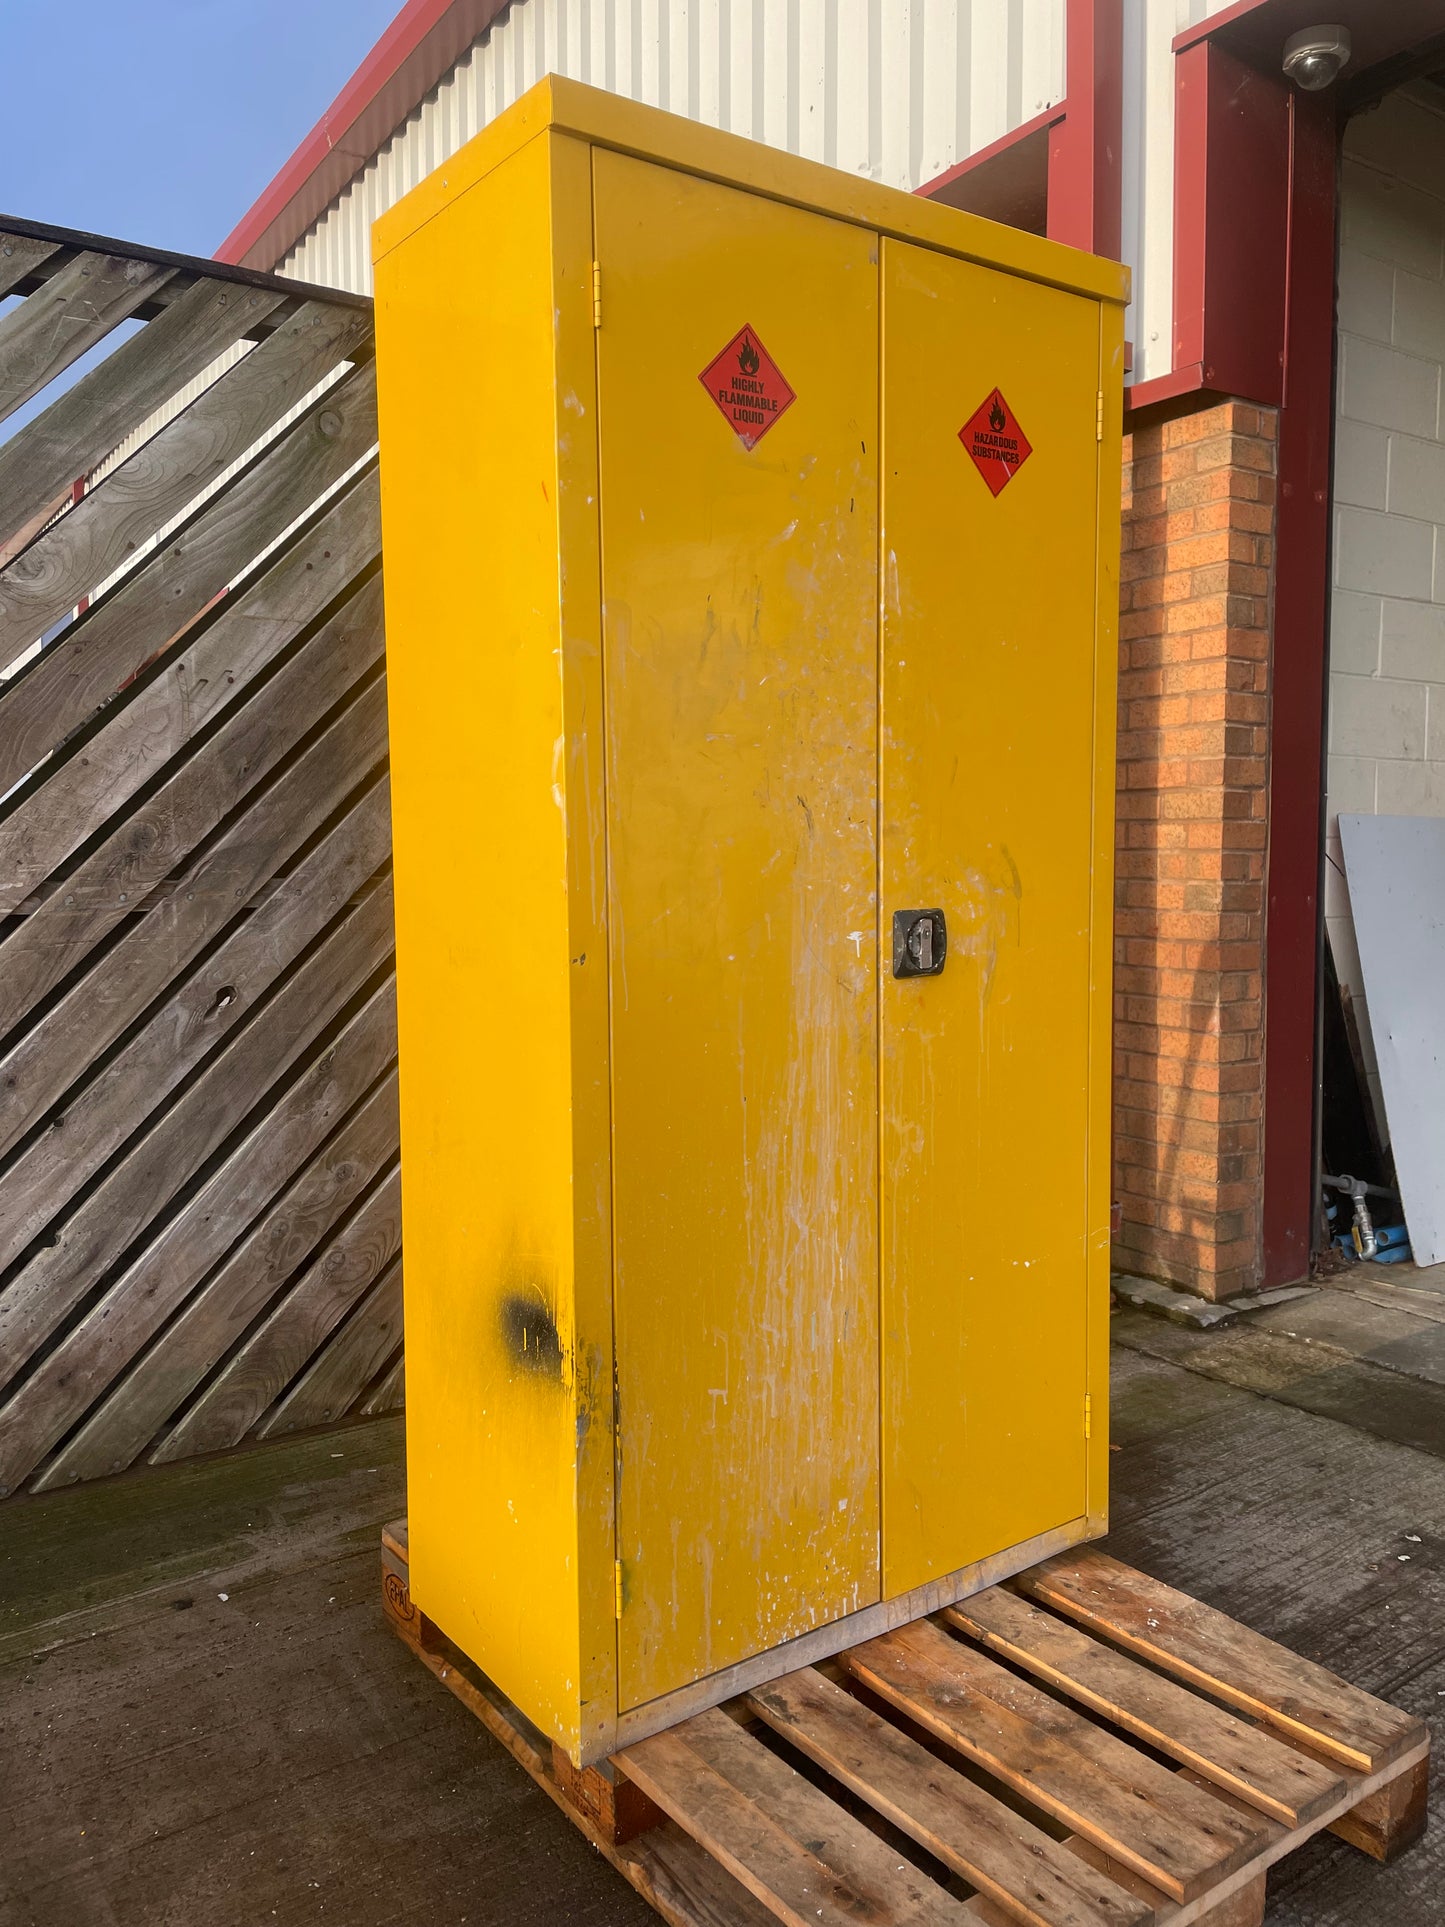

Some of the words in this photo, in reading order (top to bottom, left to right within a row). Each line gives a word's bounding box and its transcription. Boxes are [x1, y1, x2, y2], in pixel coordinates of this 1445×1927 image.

[732, 377, 765, 394] HIGHLY
[719, 390, 778, 412] FLAMMABLE
[733, 408, 764, 425] LIQUID
[974, 432, 1018, 450] HAZARDOUS
[972, 445, 1019, 464] SUBSTANCES
[390, 1579, 411, 1616] EPAL
